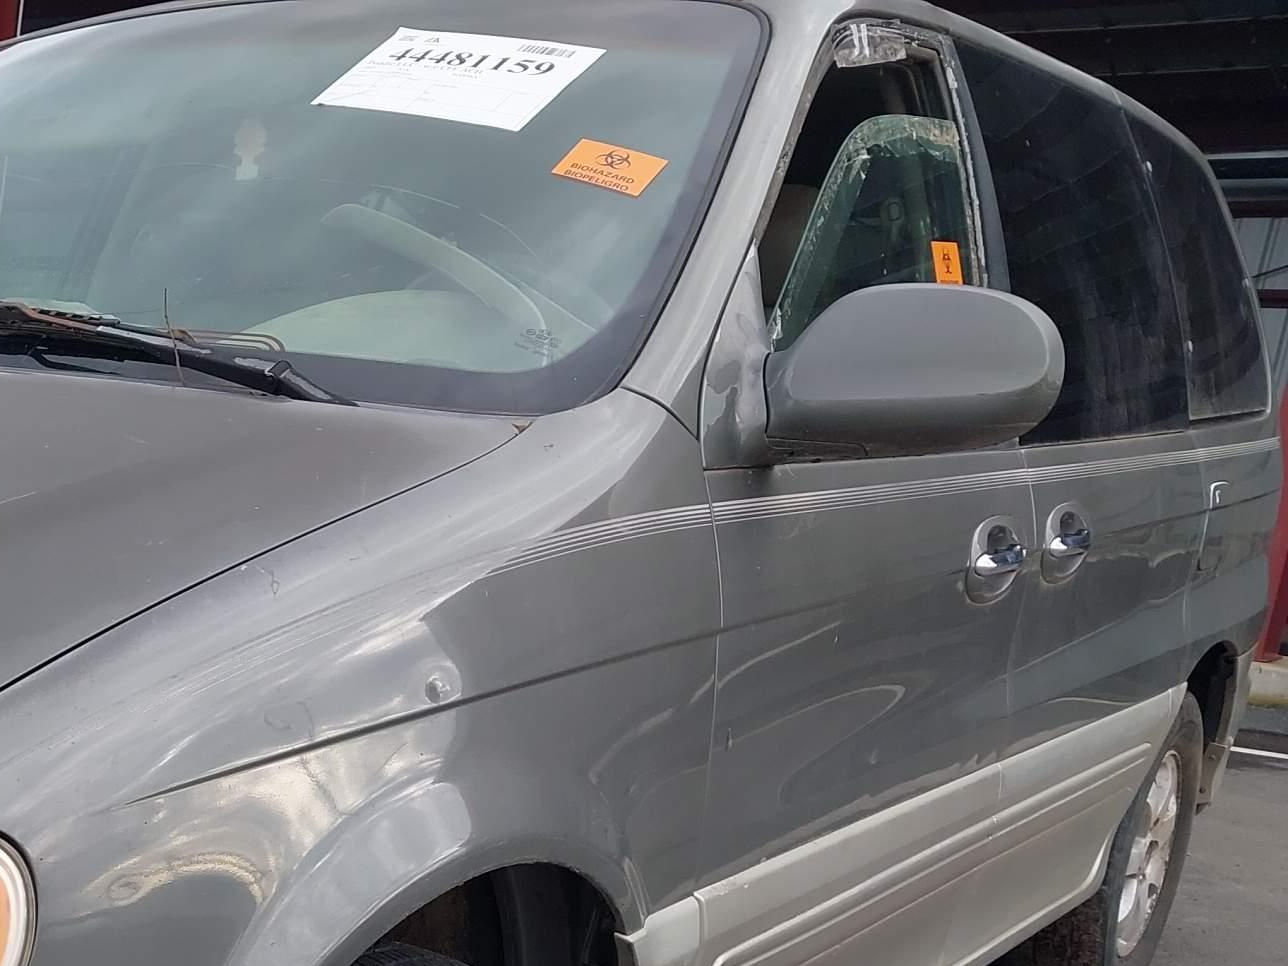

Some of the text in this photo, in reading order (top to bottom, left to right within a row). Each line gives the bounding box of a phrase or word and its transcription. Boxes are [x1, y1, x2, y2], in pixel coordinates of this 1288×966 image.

[387, 47, 557, 76] 44481159
[563, 169, 629, 191] BIOPELIGRO
[570, 162, 635, 184] BIOHAZARD
